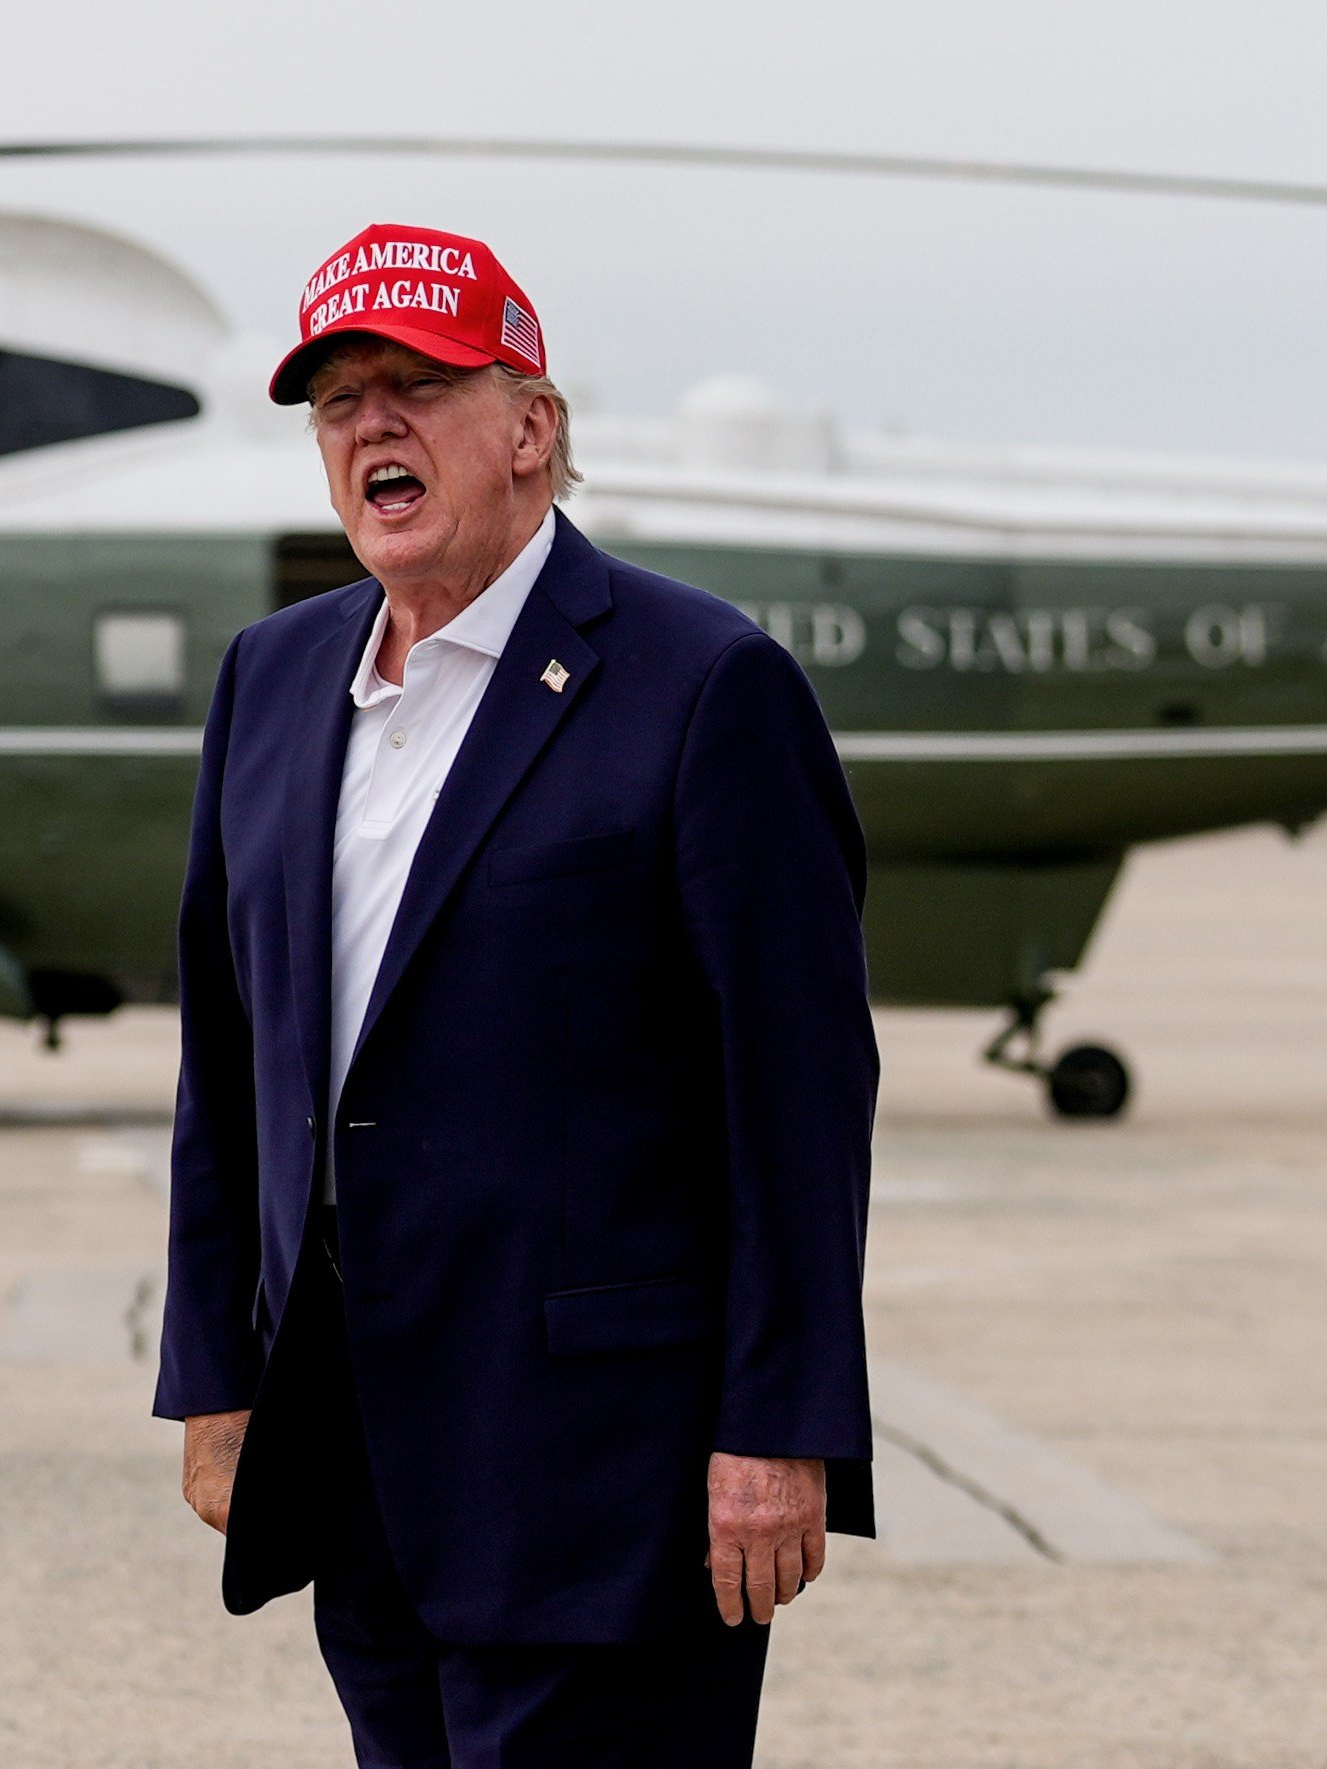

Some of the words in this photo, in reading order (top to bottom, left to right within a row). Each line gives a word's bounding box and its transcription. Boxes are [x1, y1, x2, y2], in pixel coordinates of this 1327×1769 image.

[303, 253, 351, 312] MAKE
[351, 241, 477, 280] AMERICA
[310, 283, 370, 336] GREAT
[371, 281, 461, 317] AGAIN
[896, 605, 1157, 673] STATES
